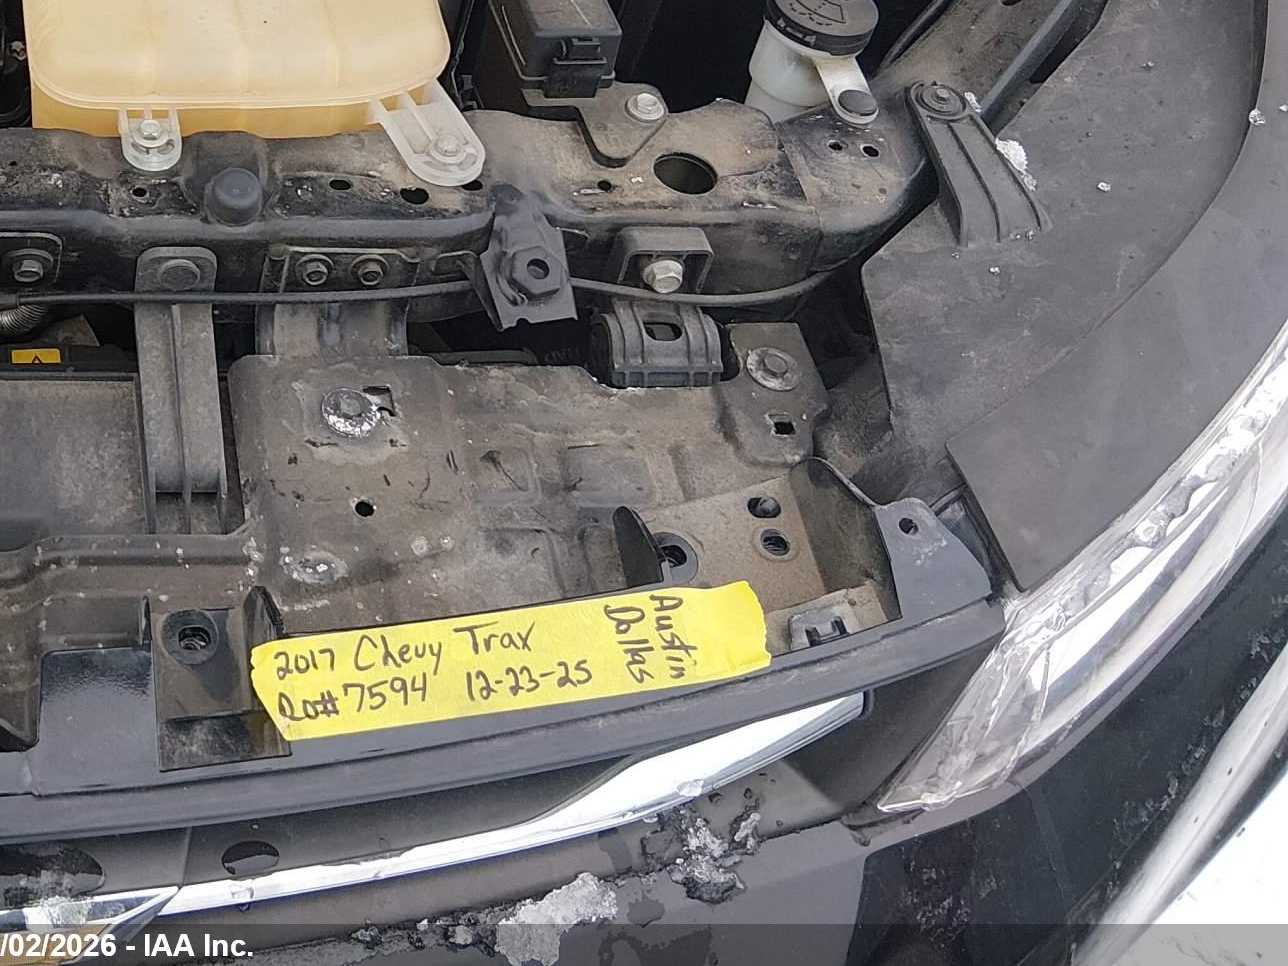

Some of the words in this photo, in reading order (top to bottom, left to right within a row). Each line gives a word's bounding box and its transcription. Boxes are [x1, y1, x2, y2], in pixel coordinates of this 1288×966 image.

[274, 648, 335, 680] 2017
[353, 634, 442, 676] Chevy
[453, 621, 537, 655] Trax
[649, 594, 698, 680] Austin
[465, 659, 593, 702] 12-23-25
